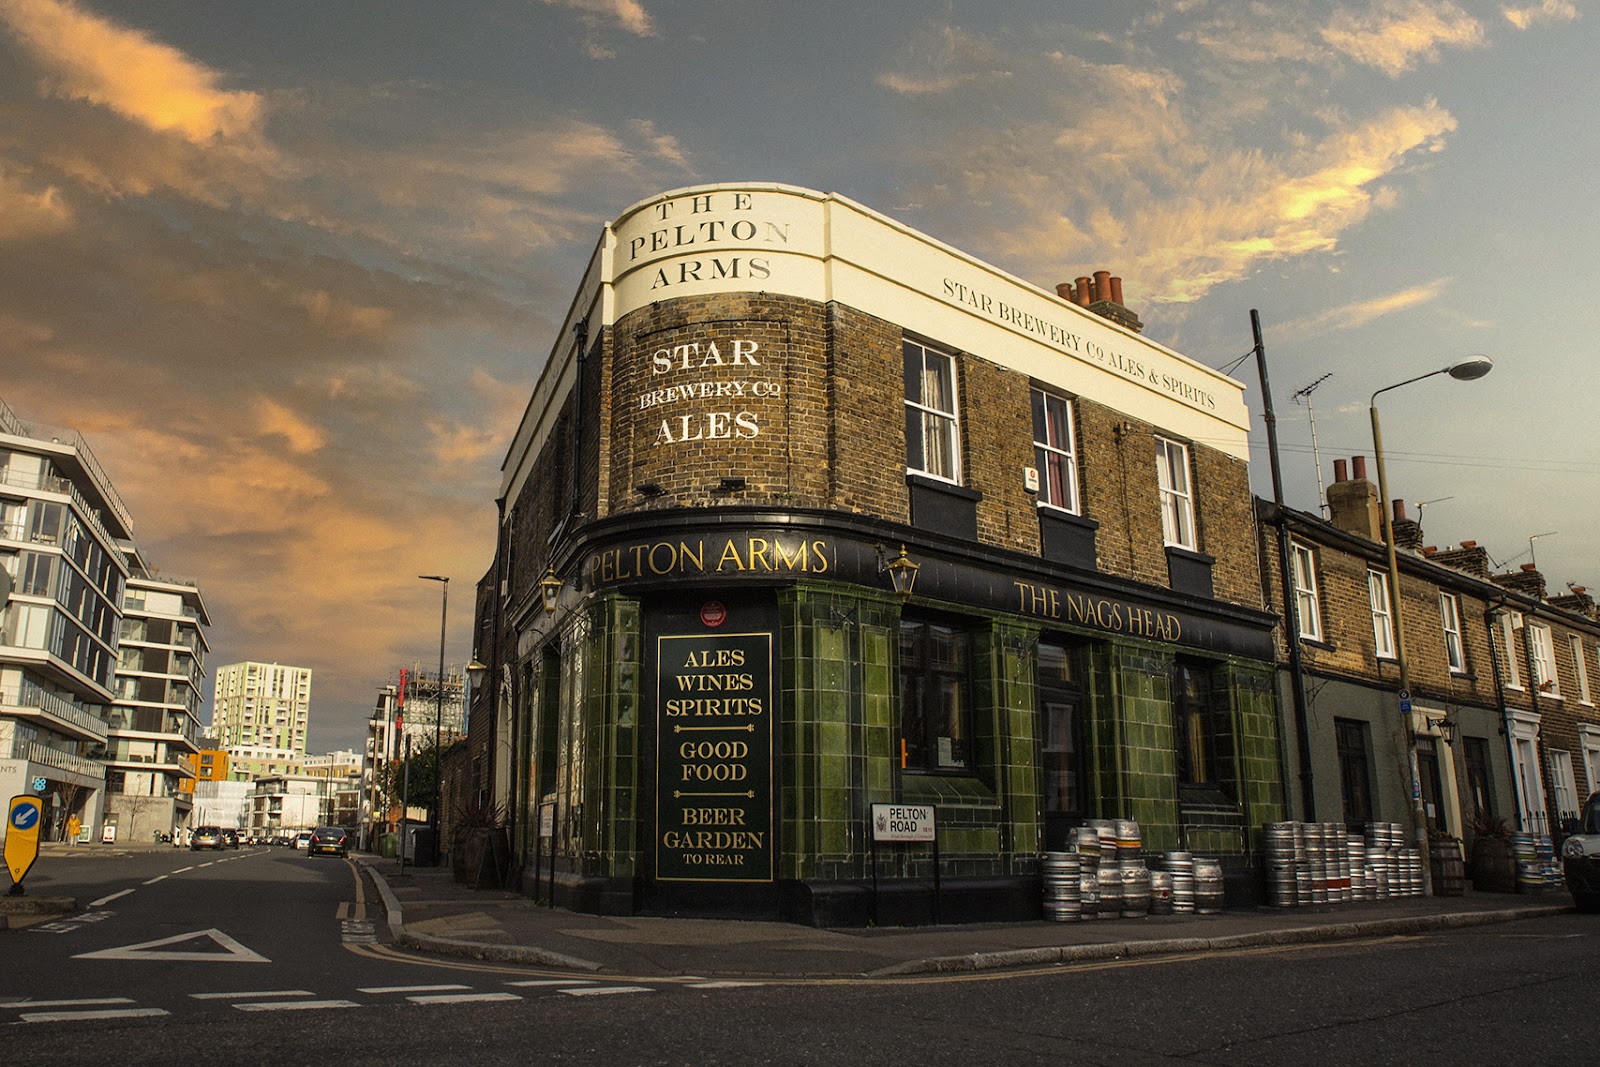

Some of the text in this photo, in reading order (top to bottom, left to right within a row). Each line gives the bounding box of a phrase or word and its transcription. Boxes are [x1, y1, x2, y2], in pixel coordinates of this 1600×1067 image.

[656, 193, 752, 222] THE
[629, 220, 790, 262] PELTON
[650, 257, 771, 290] ARMS
[943, 278, 993, 314] STAR
[998, 301, 1081, 352] BREWERY
[1108, 352, 1145, 379] ALES
[1148, 369, 1159, 385] &
[1162, 373, 1216, 410] SPIRITS
[652, 340, 761, 376] STAR
[639, 381, 749, 410] BREWERY
[653, 411, 760, 446] ALES
[591, 538, 828, 586] PELTON ARMS
[1013, 581, 1182, 642] THE NAGS HEAD
[684, 649, 745, 668] ALES
[676, 673, 754, 692] WINES
[666, 698, 763, 717] SPIRITS
[680, 741, 749, 760] GOOD
[681, 763, 747, 781] FOOD
[682, 808, 746, 826] BEER
[890, 808, 926, 820] PELTON
[890, 820, 917, 832] ROAD
[663, 831, 764, 850] GARDEN
[683, 854, 744, 866] TO REAR
